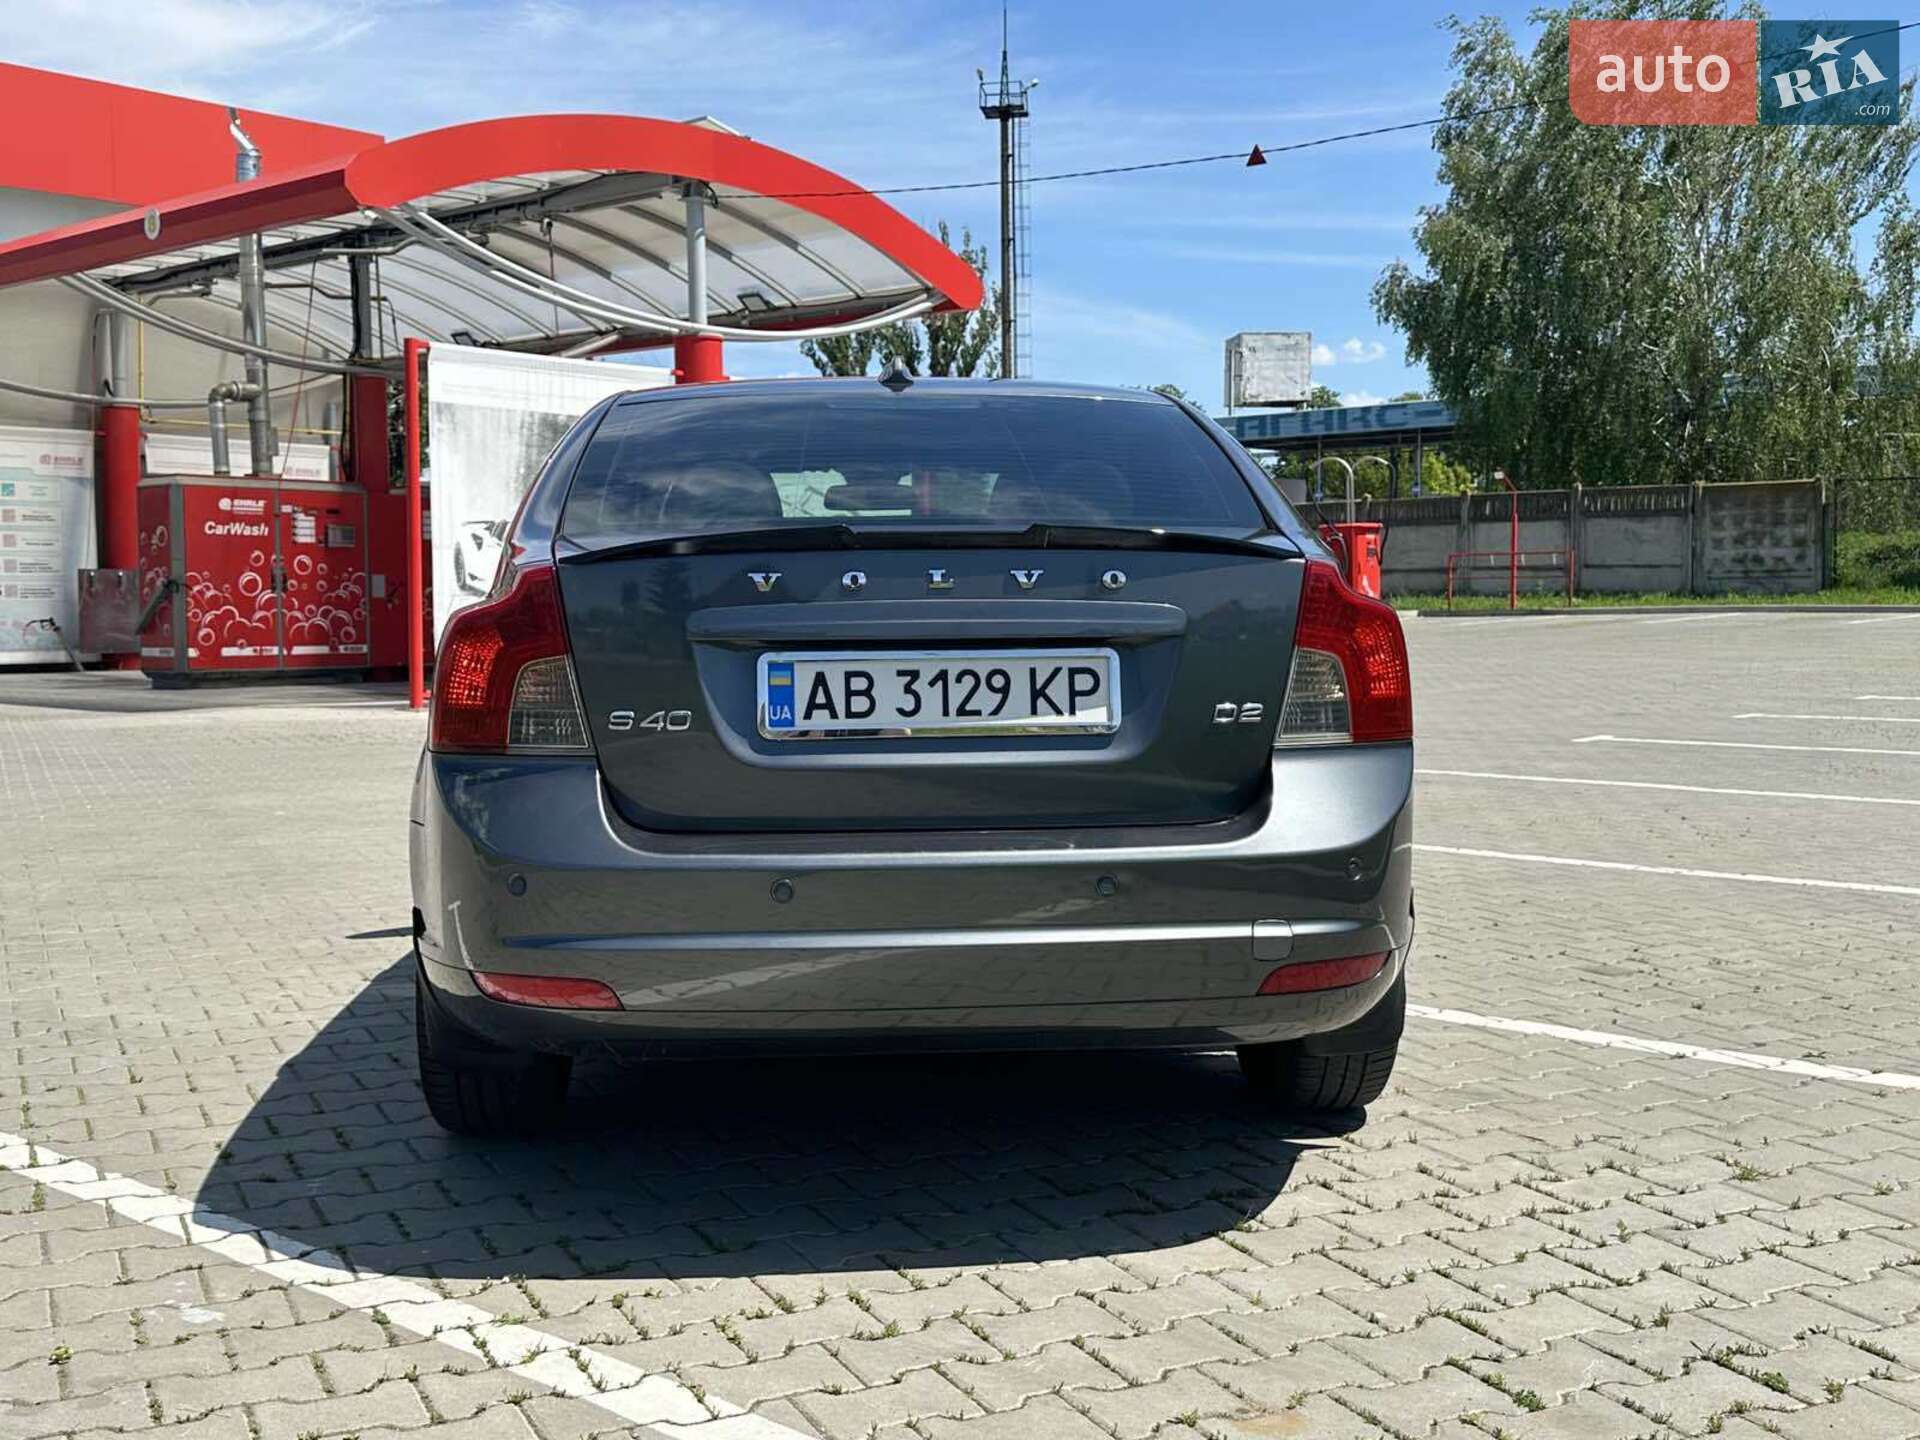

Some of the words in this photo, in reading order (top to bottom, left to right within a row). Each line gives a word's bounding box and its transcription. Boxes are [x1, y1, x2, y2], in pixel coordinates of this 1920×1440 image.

[204, 521, 269, 536] CarWash
[747, 569, 1128, 592] VOLVO
[803, 671, 877, 720] AB
[895, 669, 1012, 718] 3129
[1029, 666, 1101, 716] KP
[769, 704, 793, 721] UA
[1213, 702, 1264, 723] D2
